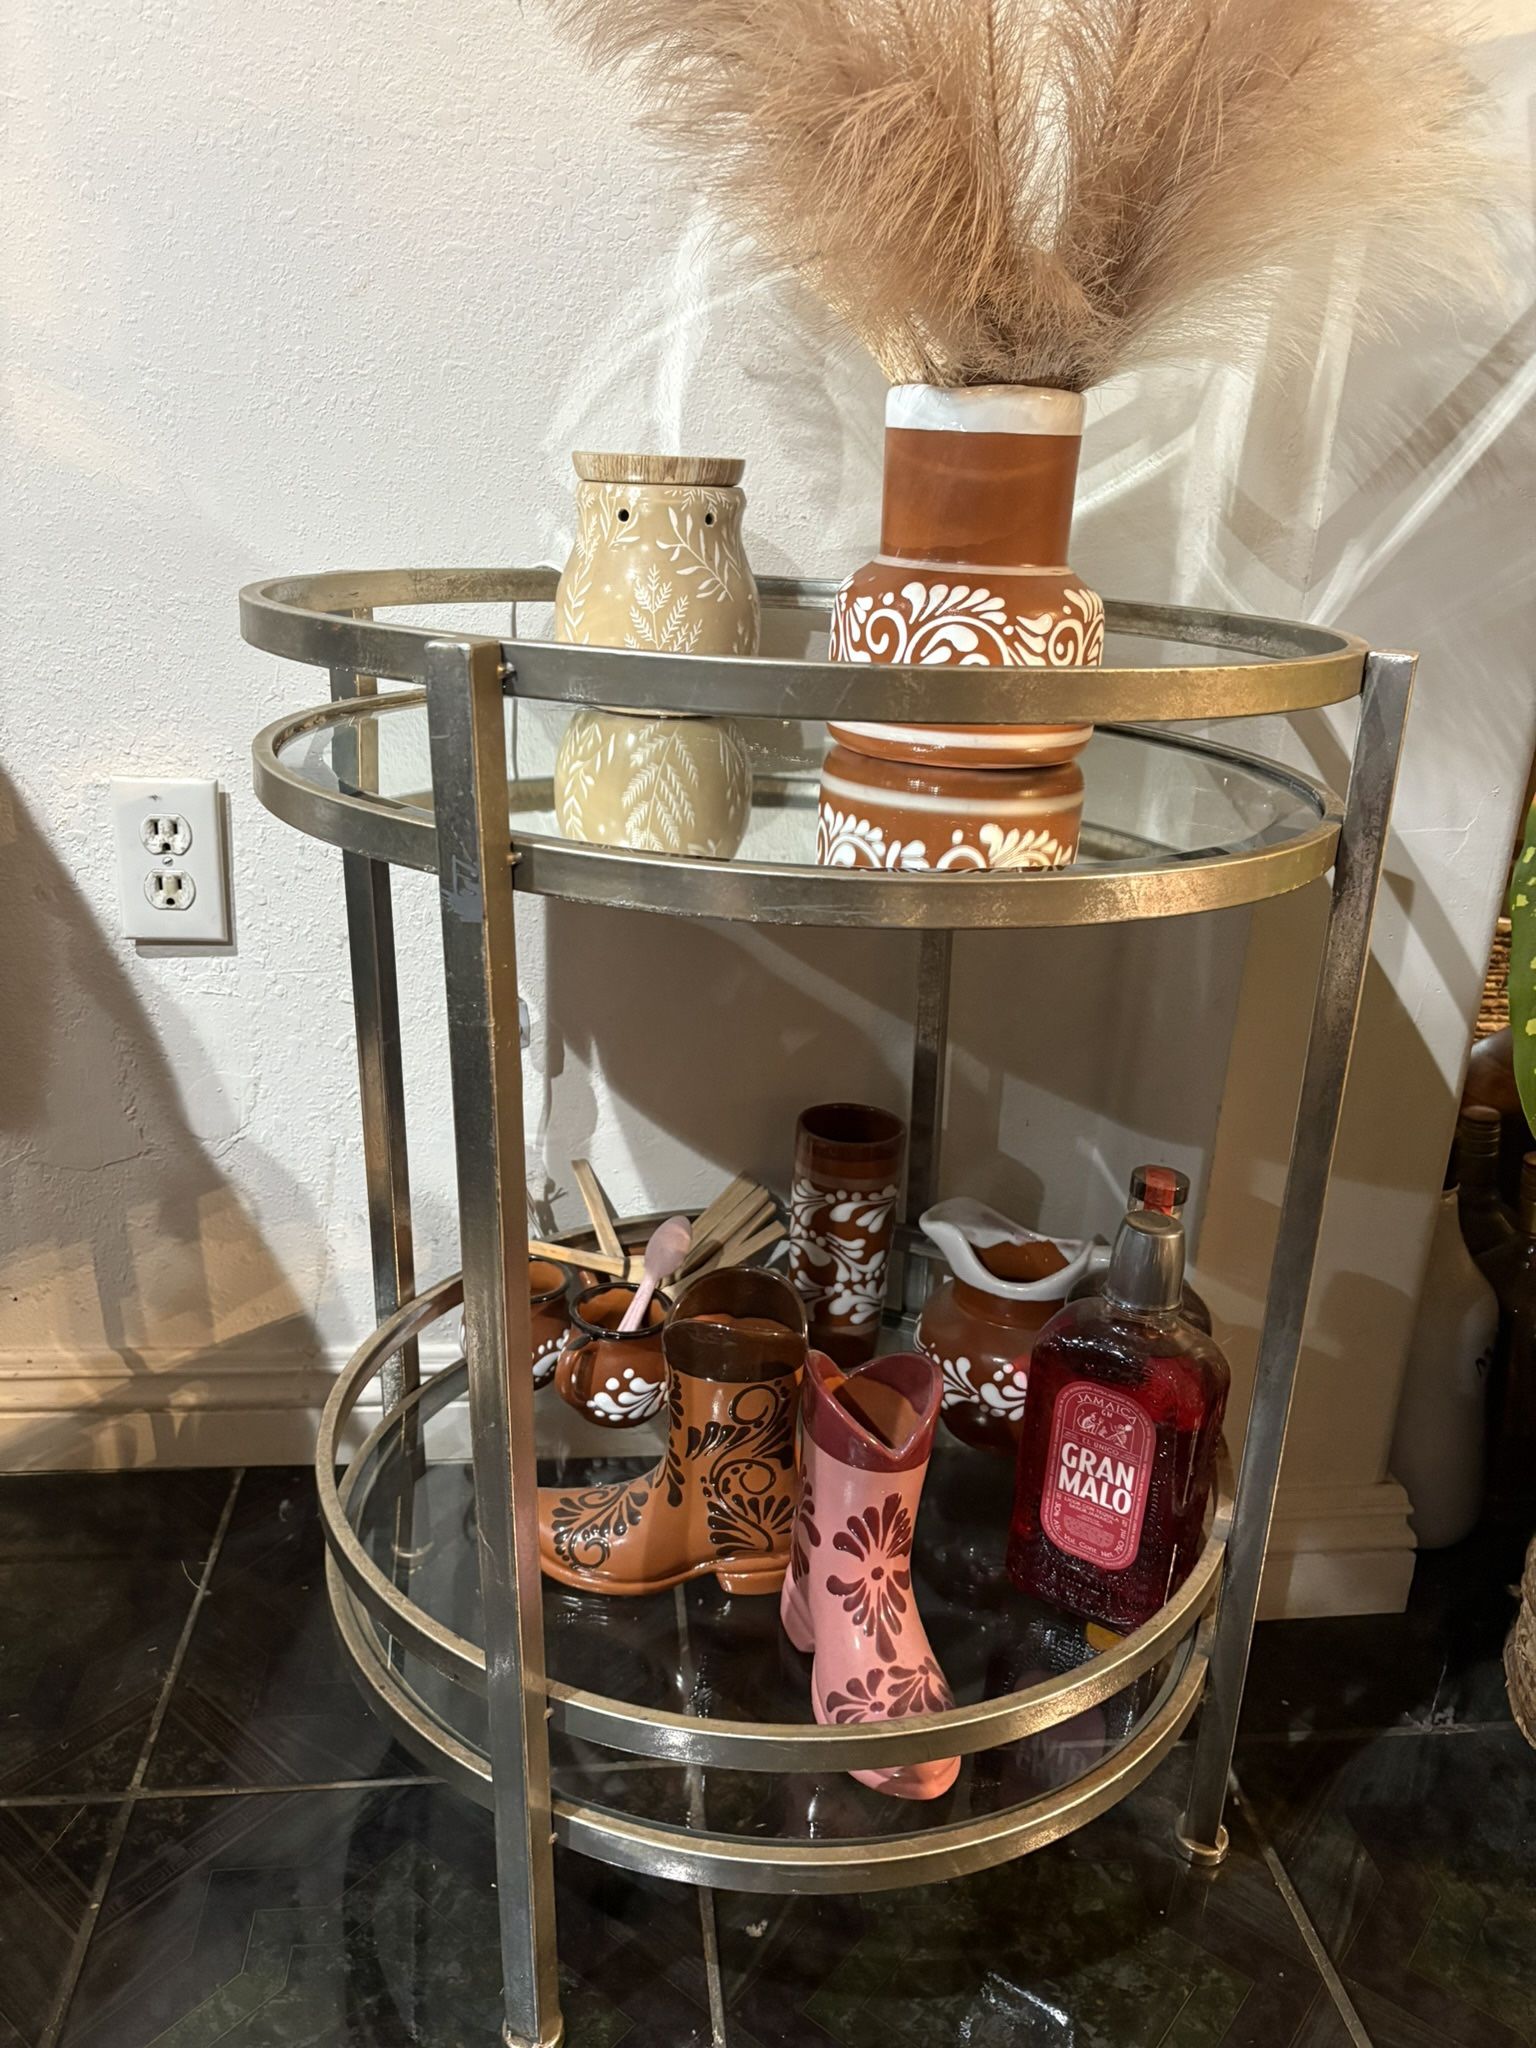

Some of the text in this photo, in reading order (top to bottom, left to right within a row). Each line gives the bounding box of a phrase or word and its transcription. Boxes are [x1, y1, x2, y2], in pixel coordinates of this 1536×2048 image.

[1076, 1394, 1136, 1425] JAMAICA
[1101, 1409, 1113, 1418] GM
[1082, 1437, 1091, 1445] EL
[1061, 1442, 1135, 1492] GRAN
[1058, 1465, 1132, 1515] MALO
[1082, 1503, 1095, 1512] CON
[1096, 1507, 1119, 1522] TEQUILA
